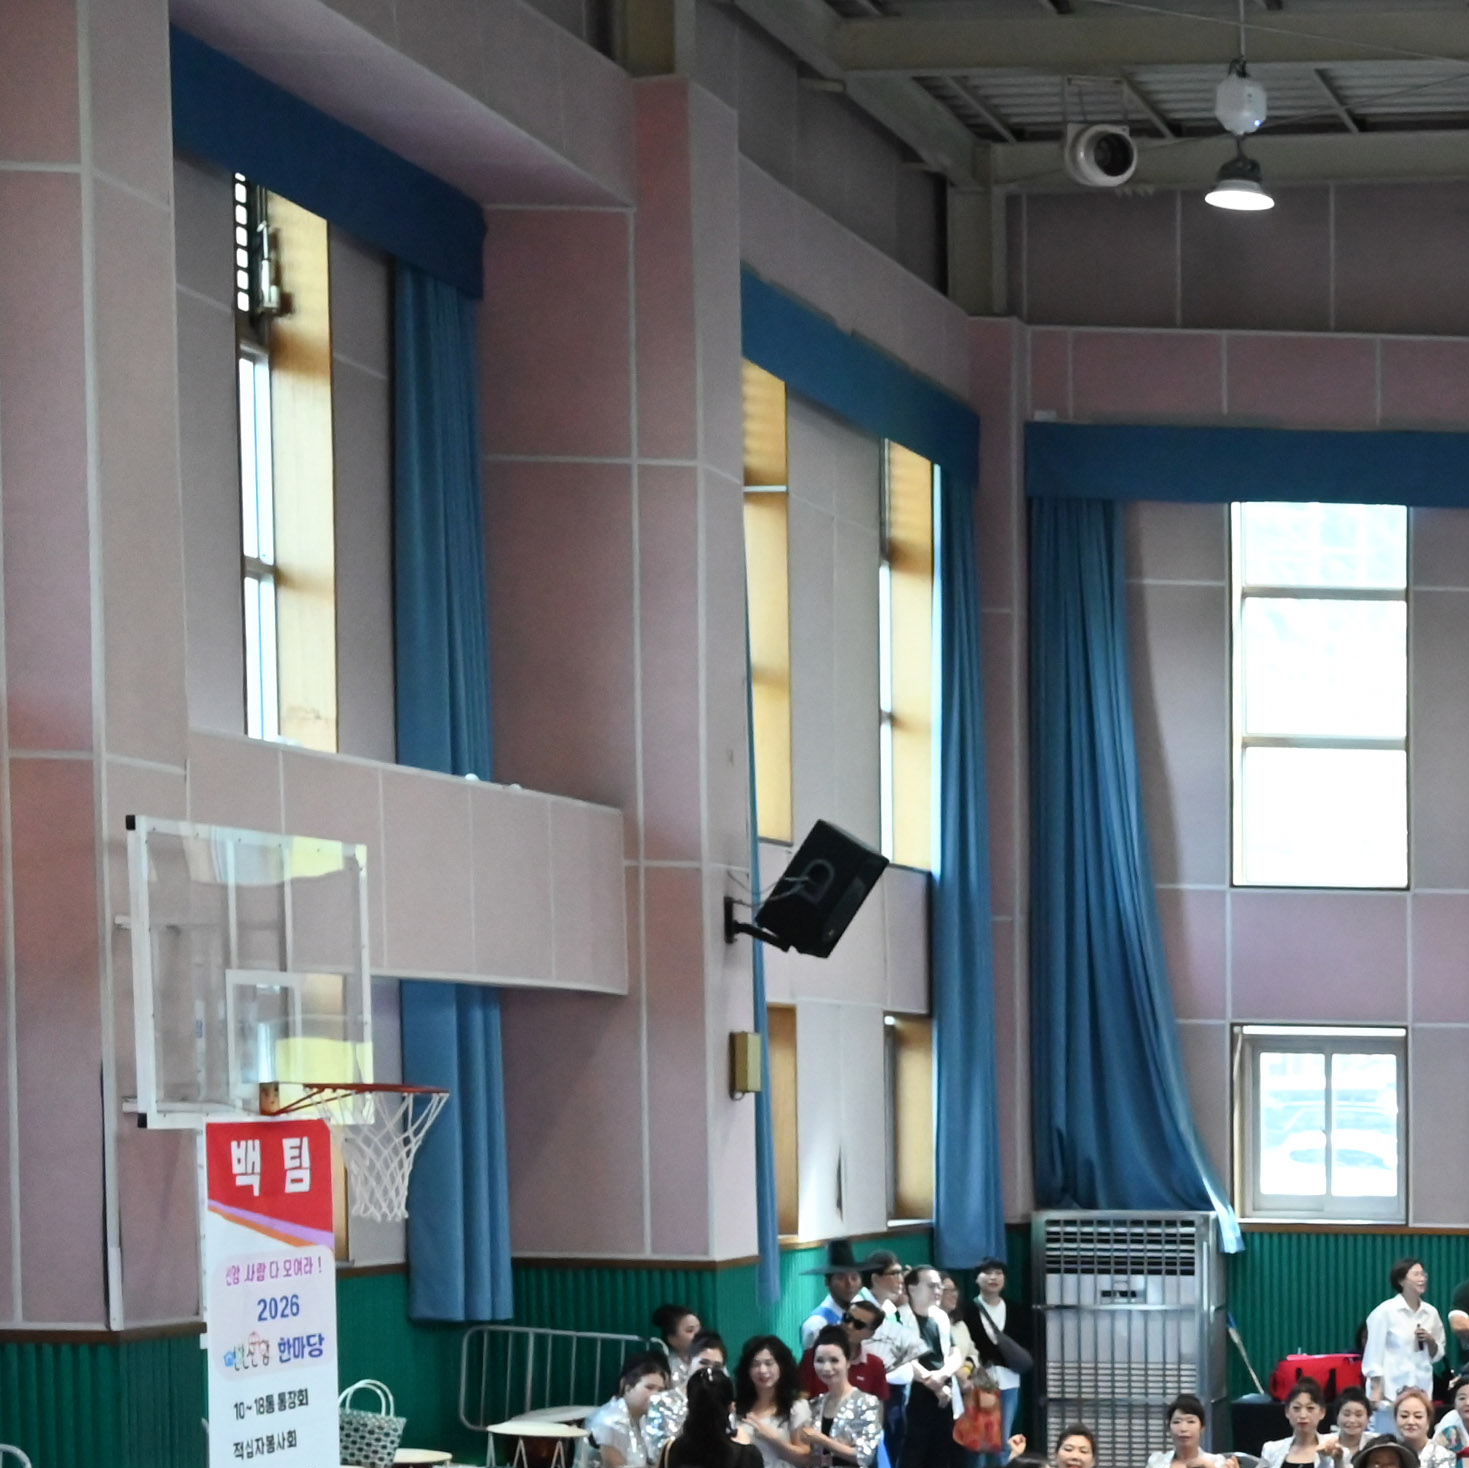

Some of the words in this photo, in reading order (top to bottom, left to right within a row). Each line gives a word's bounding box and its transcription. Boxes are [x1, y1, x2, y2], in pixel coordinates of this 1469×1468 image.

[270, 1260, 279, 1279] 다
[283, 1257, 314, 1277] 모여라
[257, 1294, 300, 1322] 2026
[278, 1333, 325, 1363] 한마당
